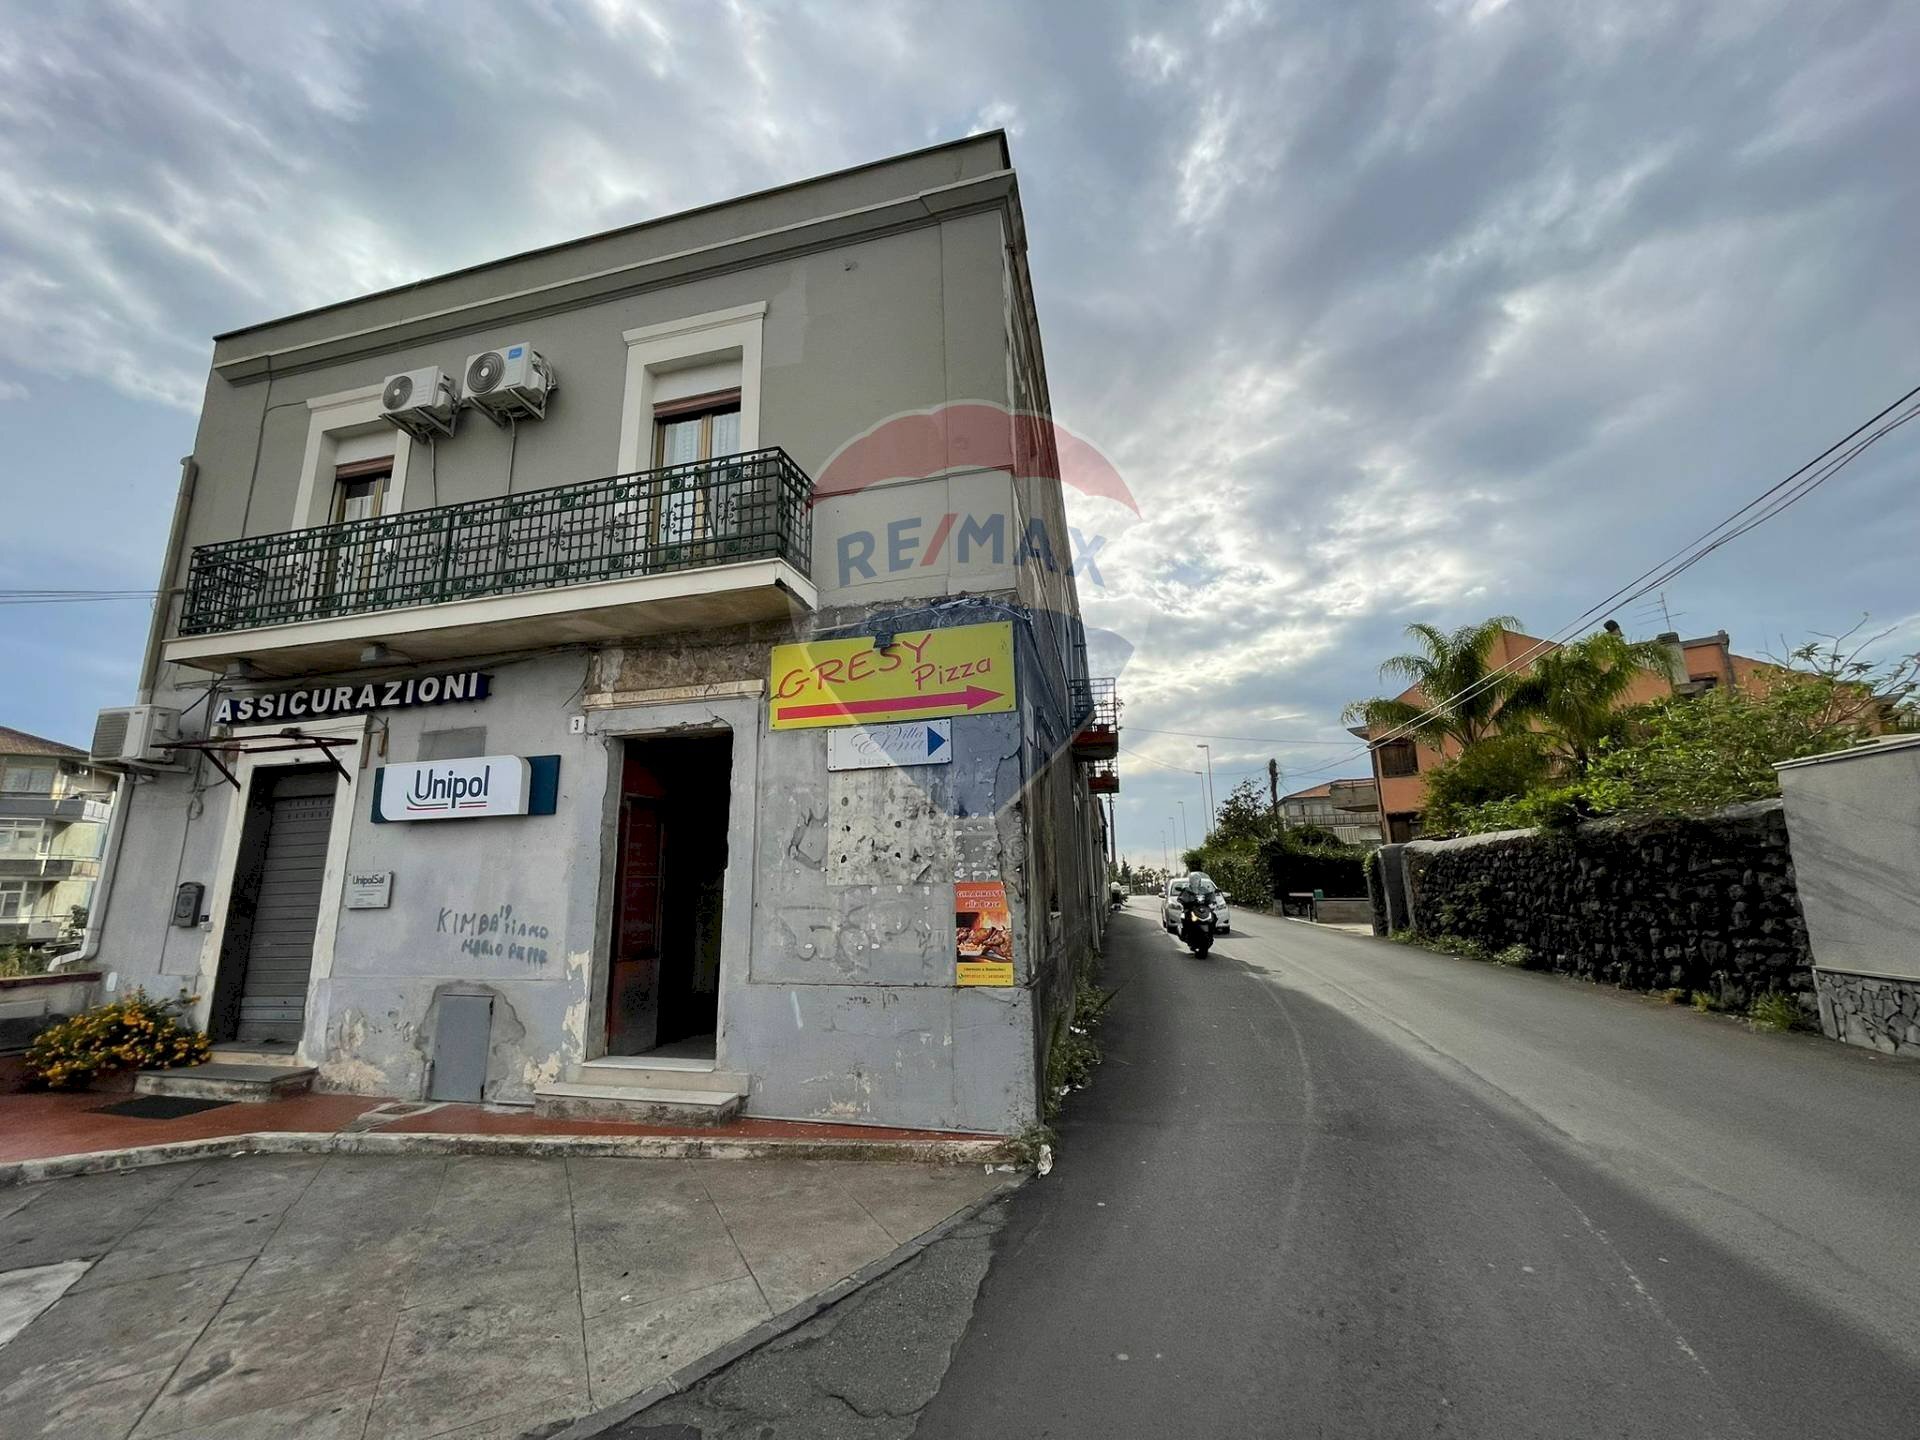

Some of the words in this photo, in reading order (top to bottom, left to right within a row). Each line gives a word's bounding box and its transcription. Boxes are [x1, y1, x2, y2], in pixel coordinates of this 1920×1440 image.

[778, 633, 932, 699] GRESY
[911, 657, 991, 690] Pizza
[215, 672, 478, 723] ASSICURAZIONI
[414, 765, 490, 809] Unipol
